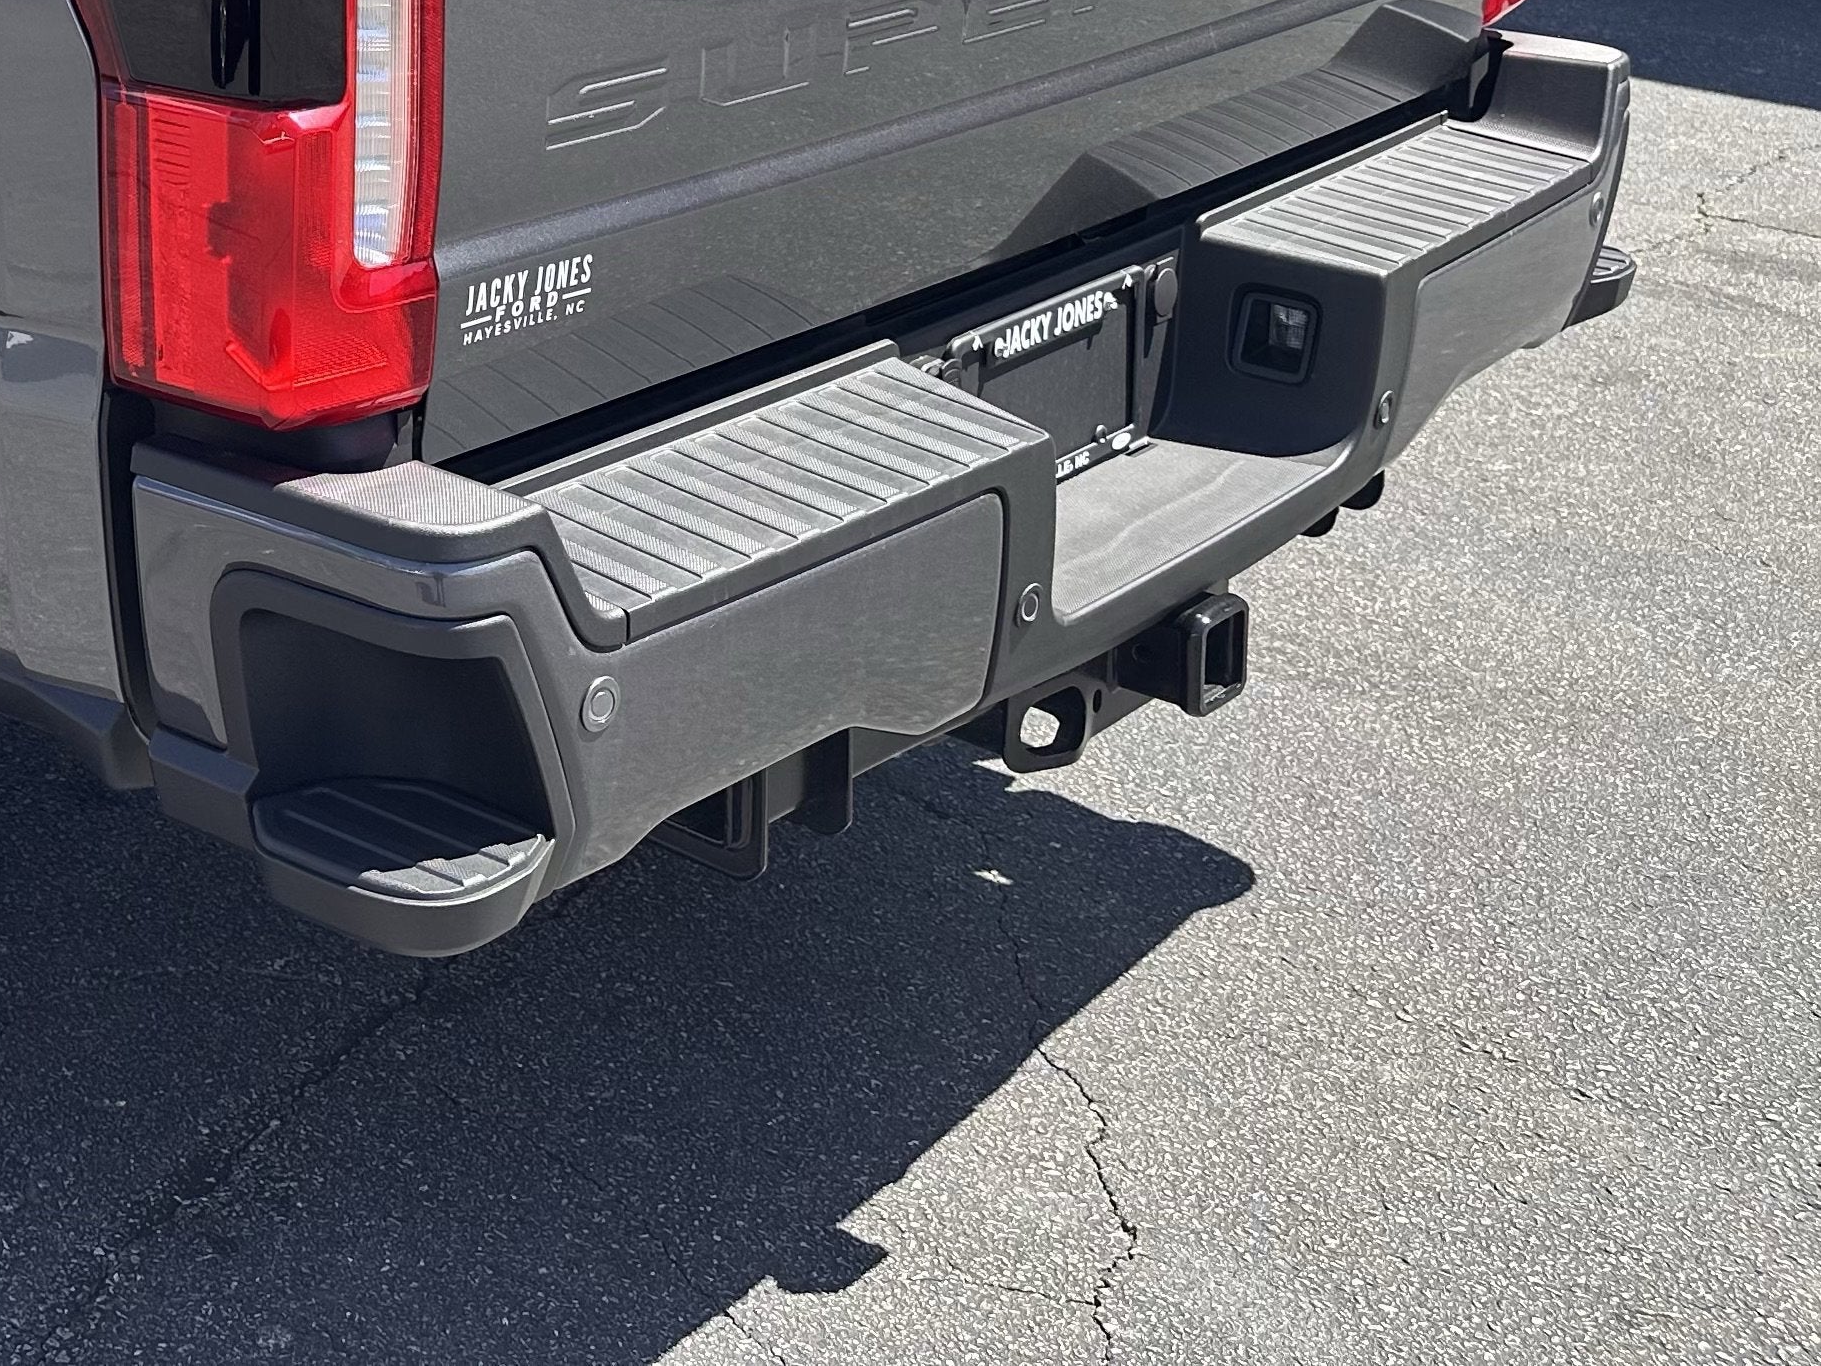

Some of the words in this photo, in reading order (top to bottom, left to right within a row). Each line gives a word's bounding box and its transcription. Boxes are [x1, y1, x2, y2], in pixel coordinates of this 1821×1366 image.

[465, 269, 529, 317] JACKY
[534, 253, 593, 296] JONES
[494, 290, 559, 323] FORD
[462, 307, 558, 346] HAYESVILLE,
[565, 299, 586, 316] NC
[1003, 311, 1053, 358] JACKY
[1054, 291, 1104, 336] JONES
